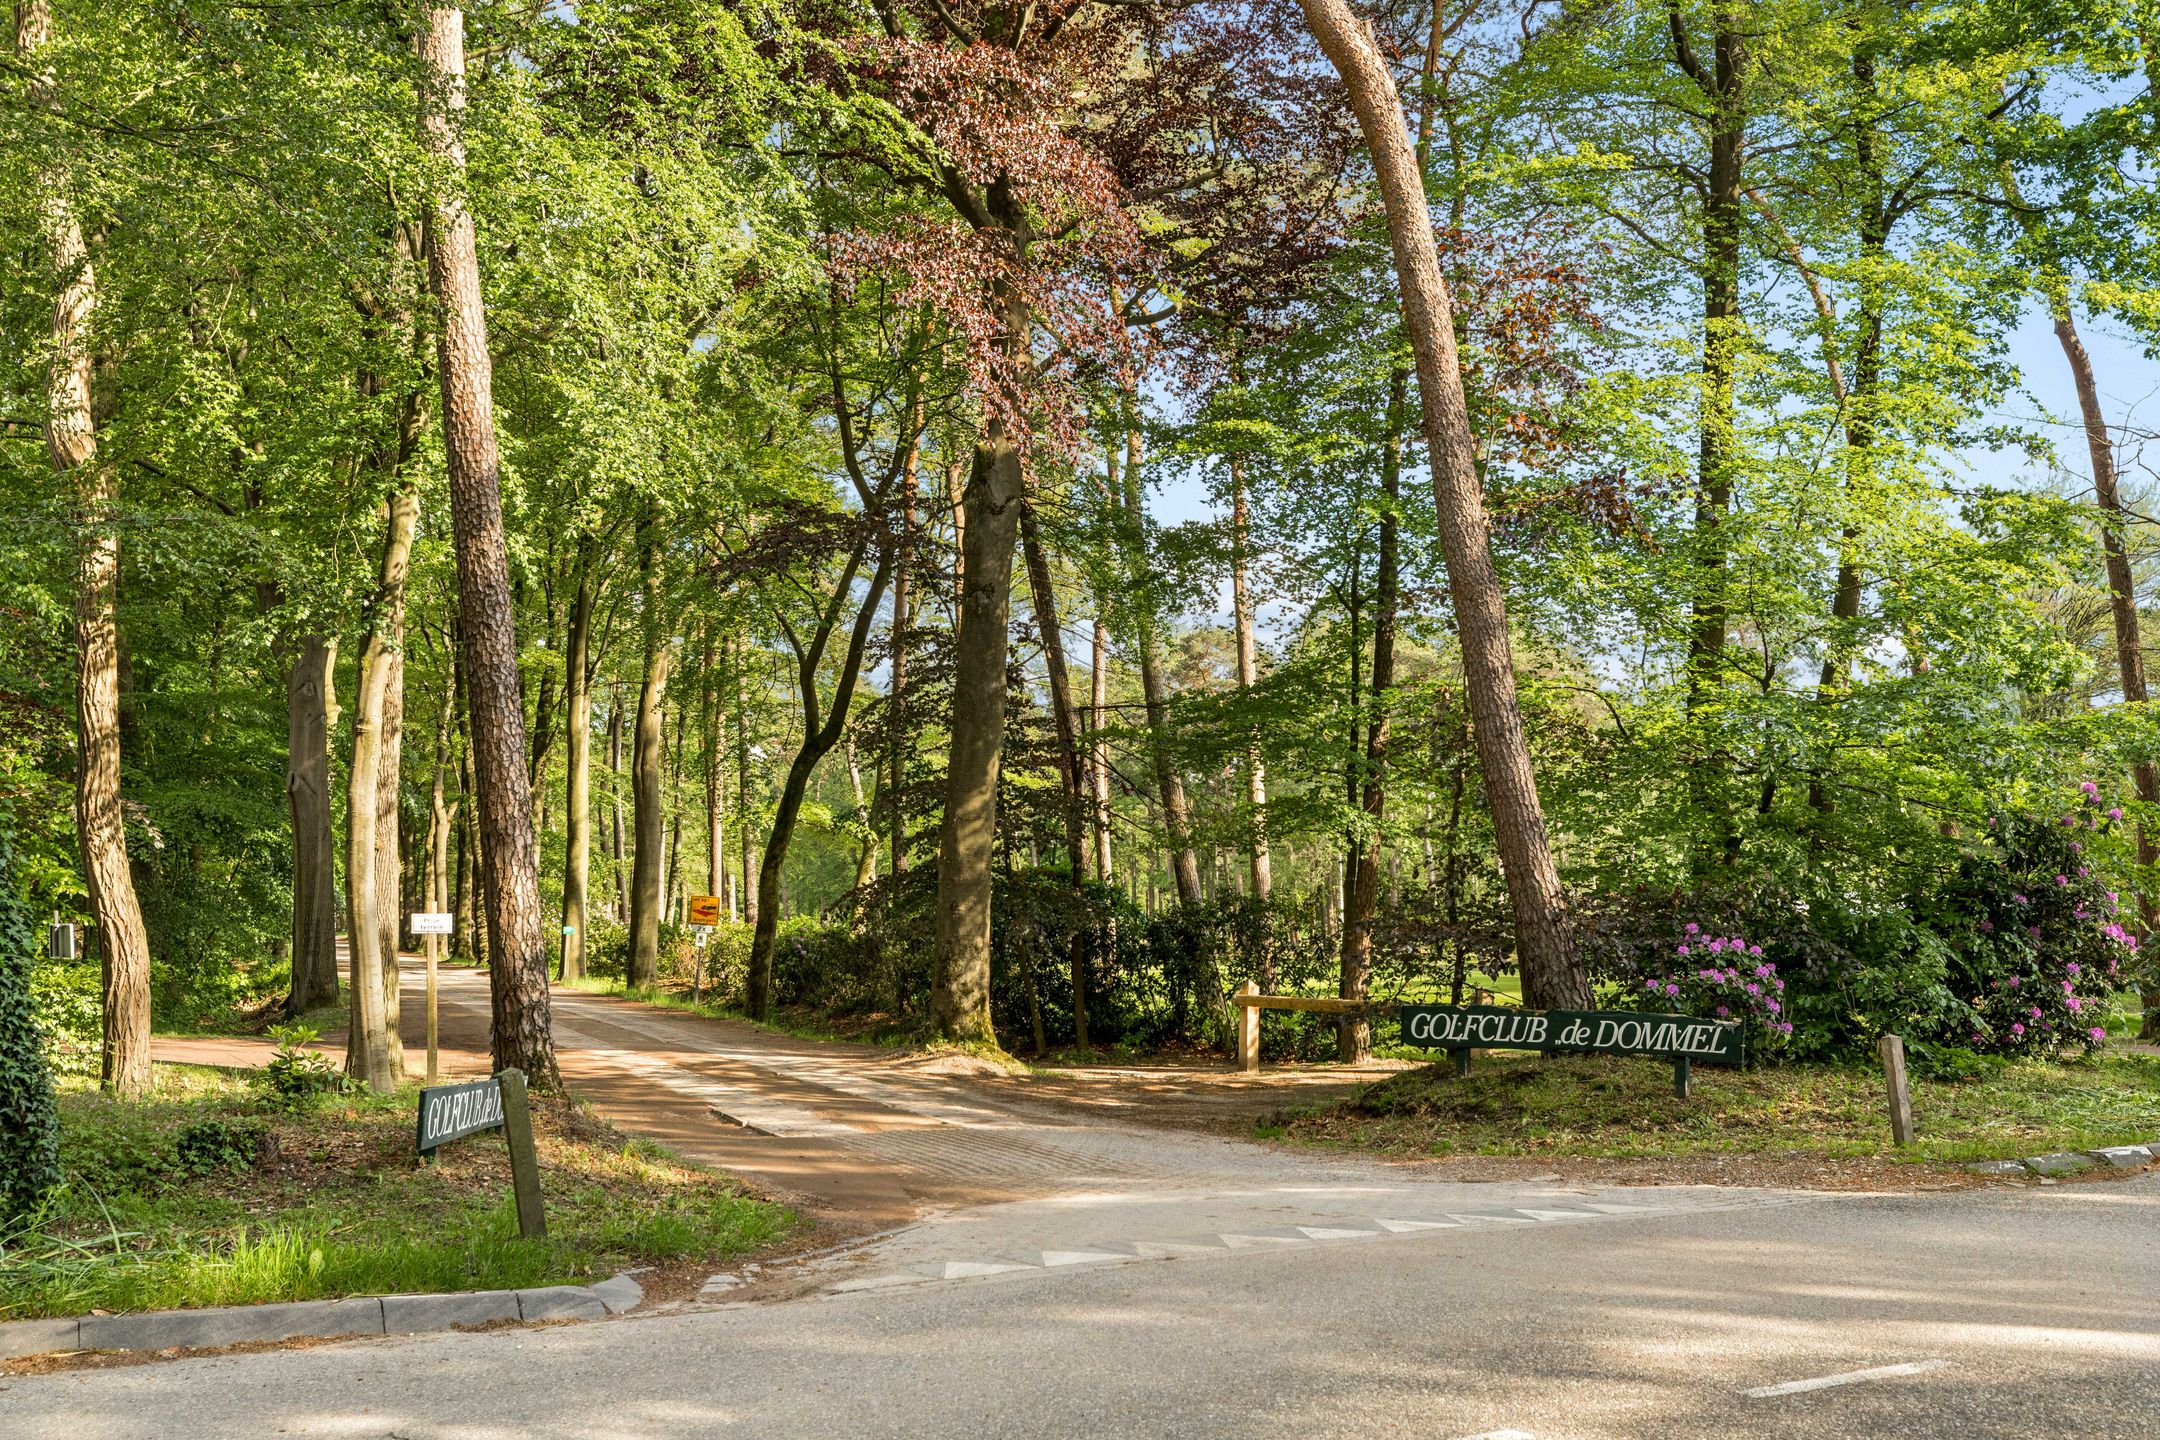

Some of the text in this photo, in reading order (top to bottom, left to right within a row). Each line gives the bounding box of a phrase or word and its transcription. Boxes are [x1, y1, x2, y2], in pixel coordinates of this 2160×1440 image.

[1410, 1012, 1549, 1043] GOLFCLUB
[1592, 1019, 1728, 1055] DOMMEL
[427, 1088, 483, 1139] GOLFCLUB
